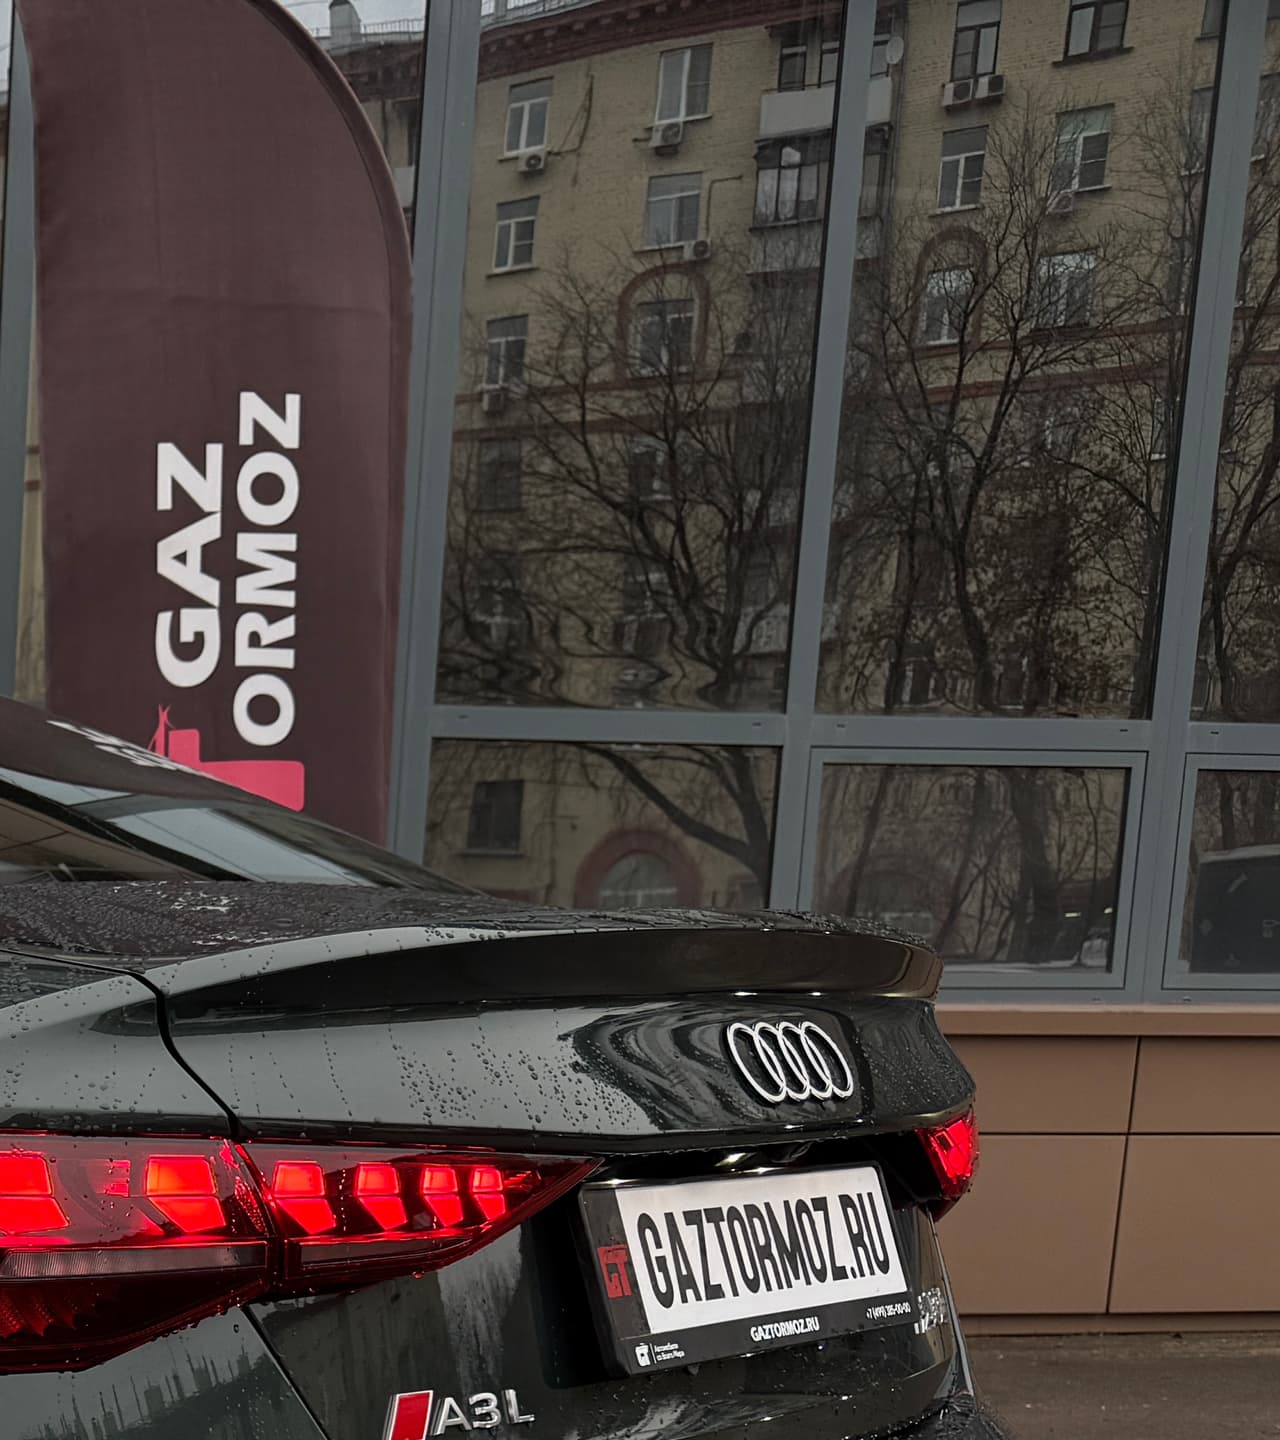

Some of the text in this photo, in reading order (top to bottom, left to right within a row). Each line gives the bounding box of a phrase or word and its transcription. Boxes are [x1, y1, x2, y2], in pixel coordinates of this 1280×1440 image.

[155, 442, 224, 688] GAZ
[233, 391, 301, 746] ORMOZ
[637, 1191, 891, 1309] GAZTORMOZ.RU
[750, 1316, 820, 1342] GAZTORMOZ.RU
[431, 1389, 536, 1436] A3L
